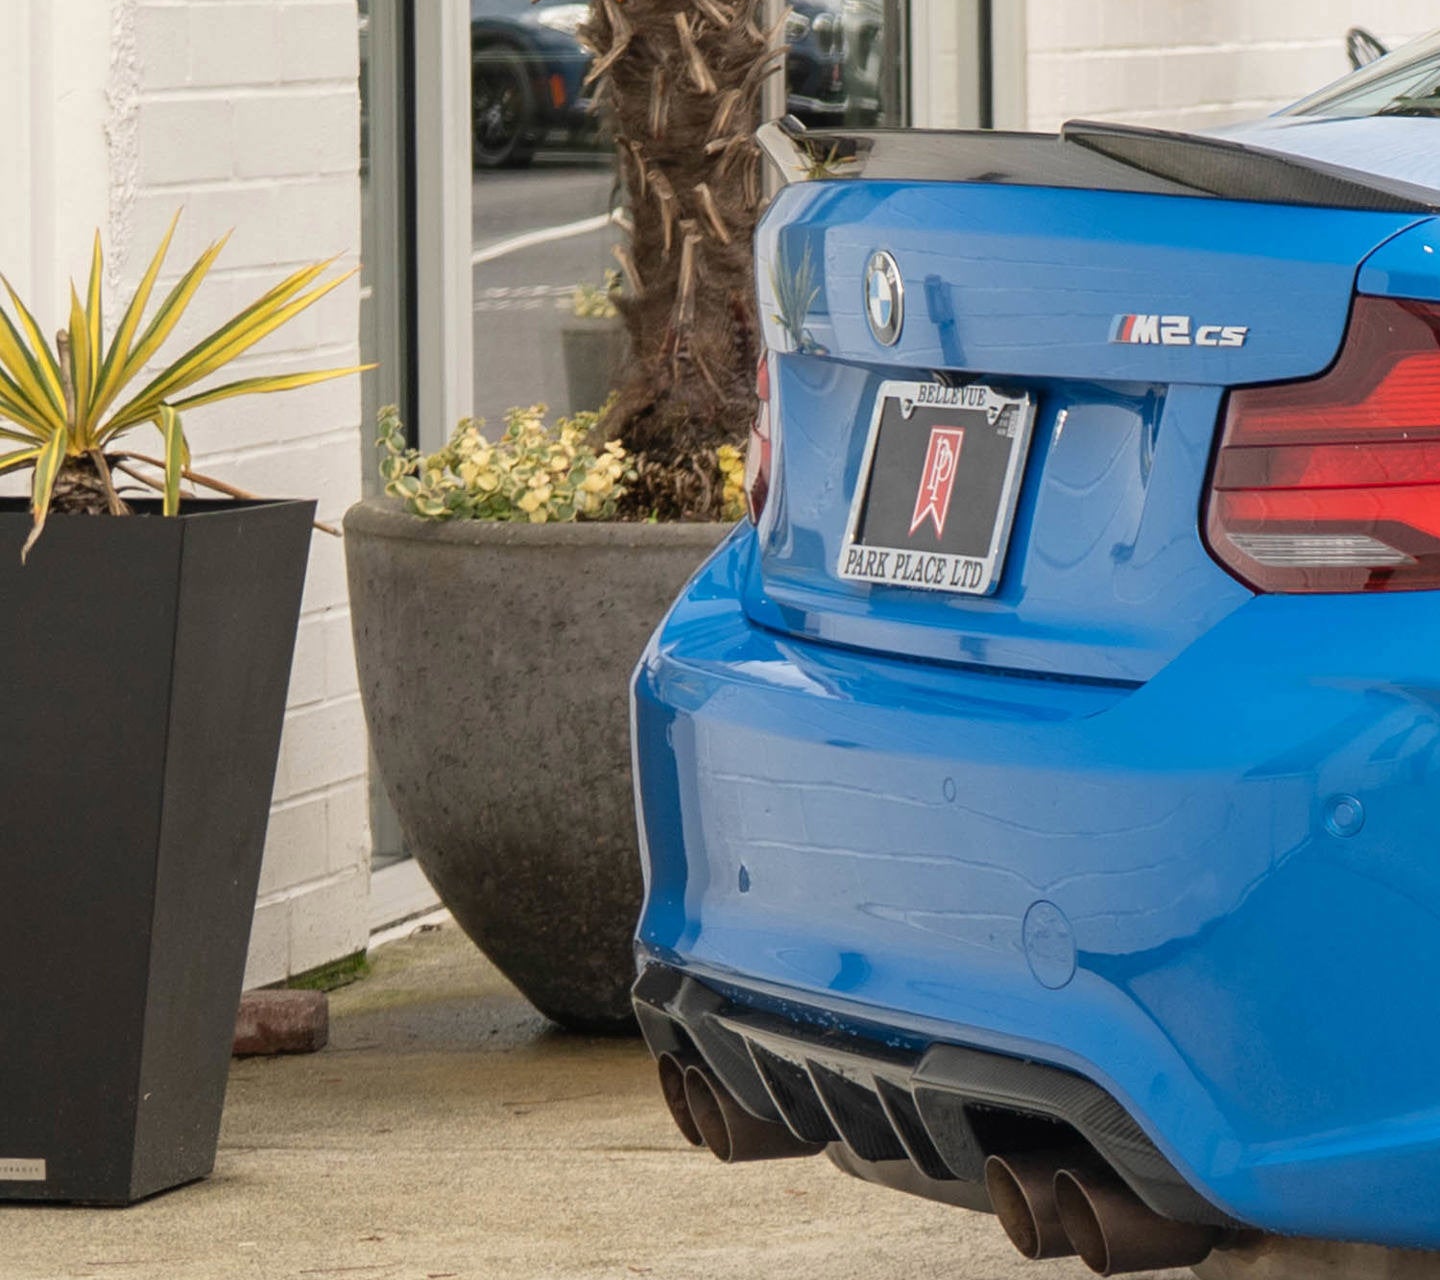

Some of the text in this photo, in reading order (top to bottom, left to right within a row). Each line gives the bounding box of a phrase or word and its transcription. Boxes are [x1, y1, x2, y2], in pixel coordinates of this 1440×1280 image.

[917, 384, 986, 407] BELLEVUE
[843, 549, 983, 589] PARK PLACE LTD
